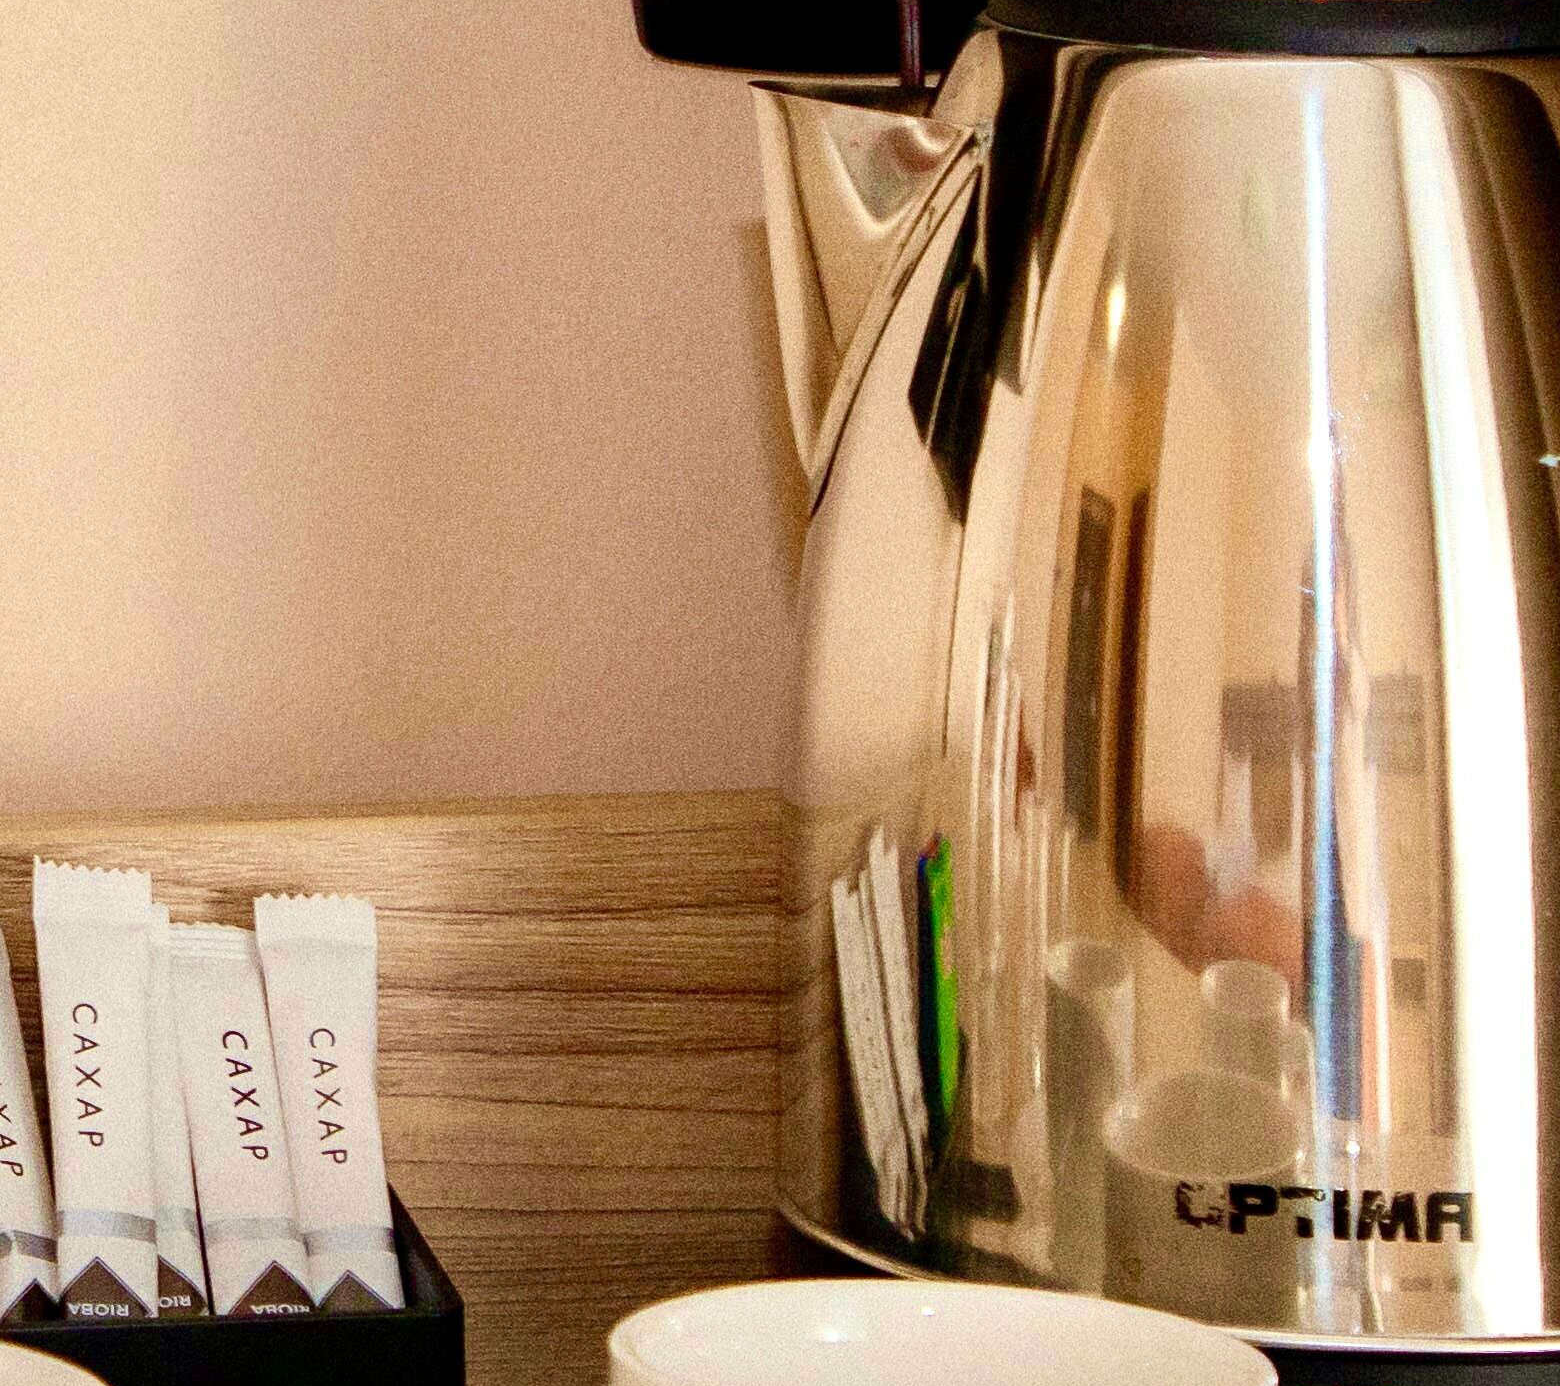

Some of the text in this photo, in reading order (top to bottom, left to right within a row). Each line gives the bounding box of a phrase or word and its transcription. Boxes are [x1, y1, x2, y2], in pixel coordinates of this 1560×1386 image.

[73, 1003, 104, 1147] САХАР
[222, 1030, 269, 1160] САХАР
[310, 1028, 348, 1164] САХАР
[67, 1302, 129, 1317] RIOBA
[159, 1295, 192, 1309] RIO
